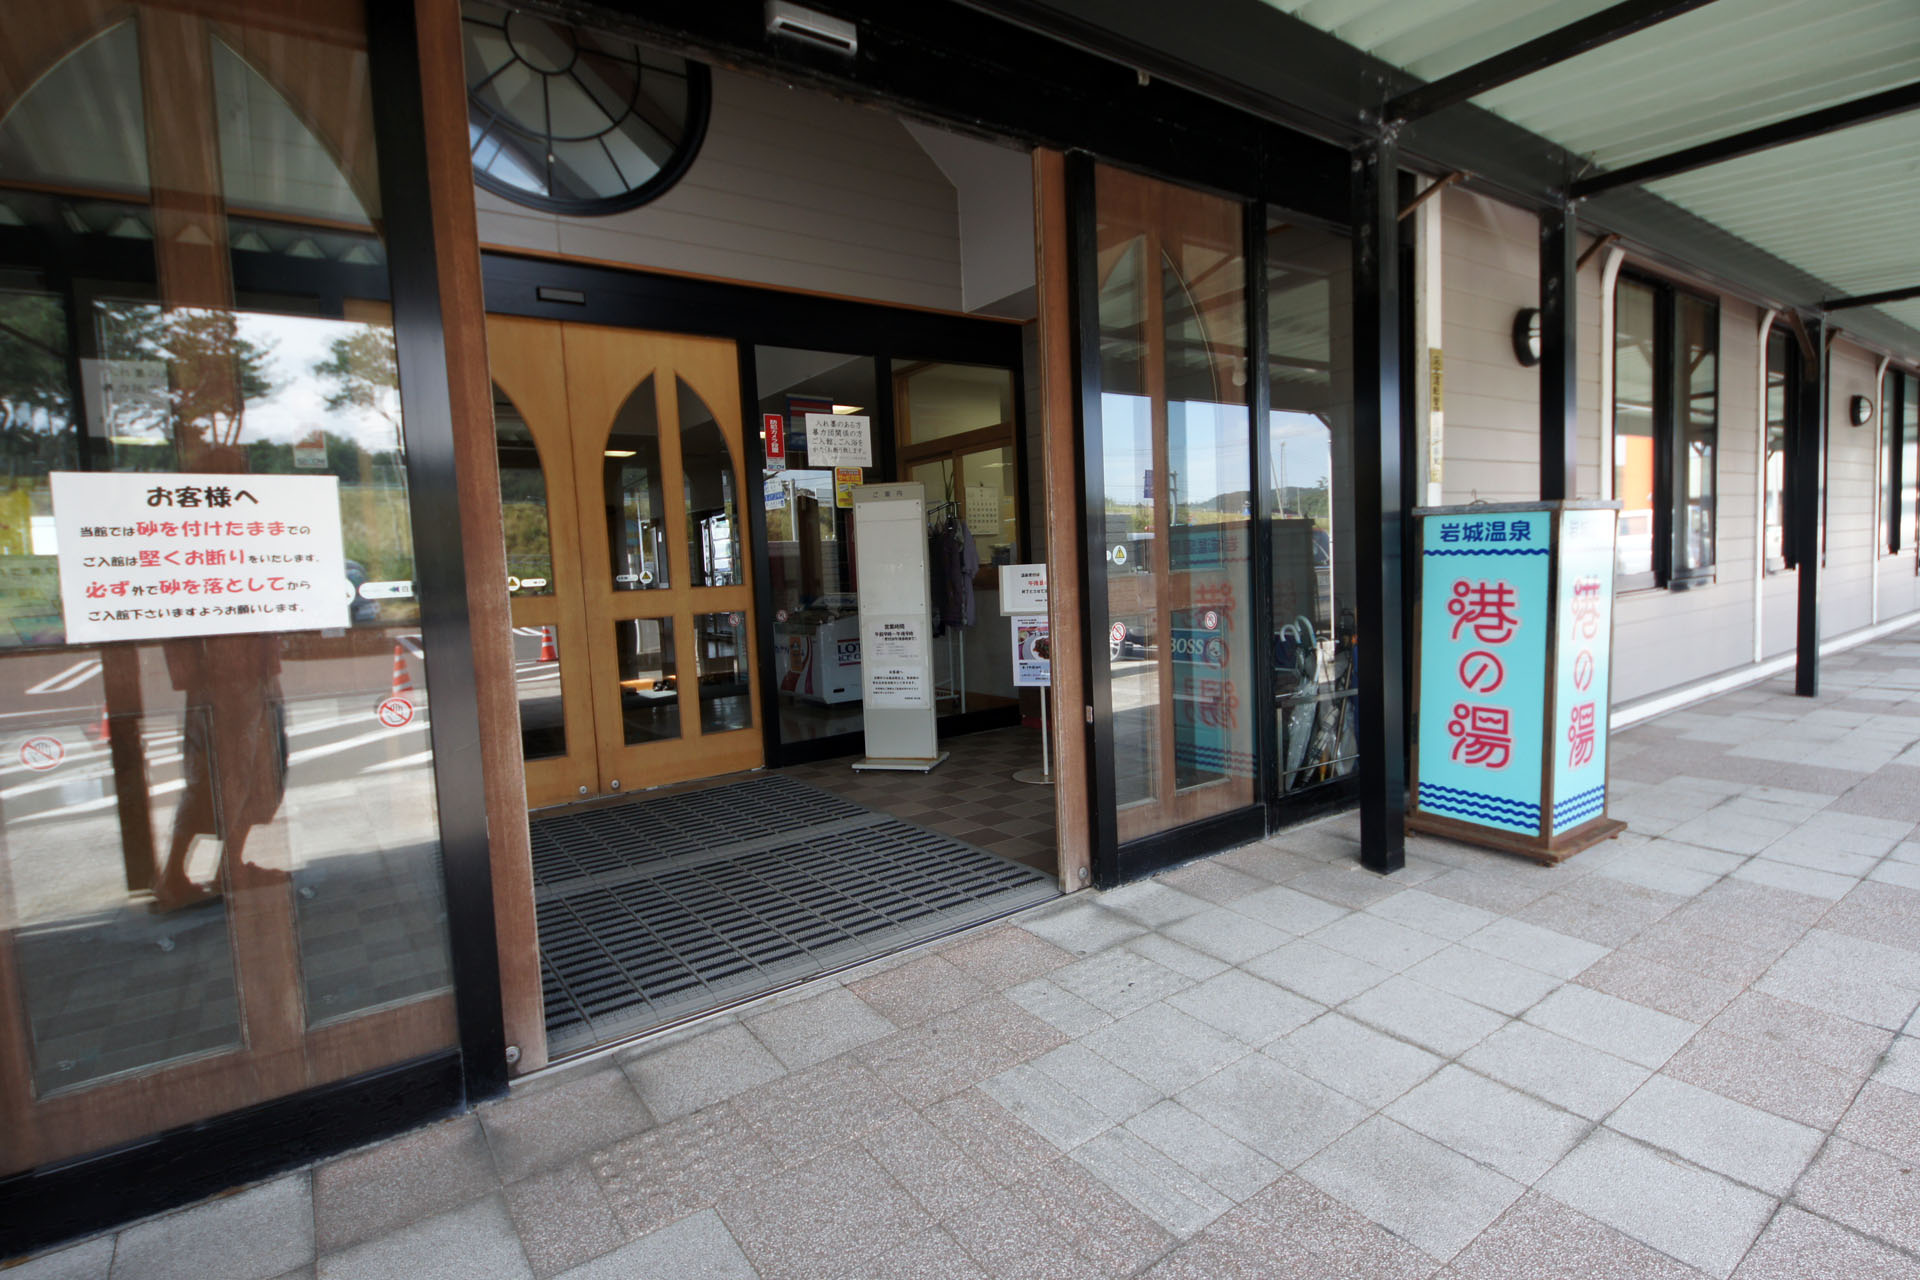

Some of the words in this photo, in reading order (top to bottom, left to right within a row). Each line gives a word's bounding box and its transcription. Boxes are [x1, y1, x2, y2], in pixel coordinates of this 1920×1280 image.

[812, 428, 863, 438] 暴力団関係の方
[816, 420, 862, 429] 入れ墨のある方
[147, 486, 259, 508] お客様へ
[1440, 520, 1531, 542] 岩城温泉
[88, 603, 304, 622] ご入館下さいますようお願いします。
[1171, 638, 1204, 654] BOSS
[1447, 580, 1518, 769] 港の湯
[1568, 576, 1601, 768] 港の湯
